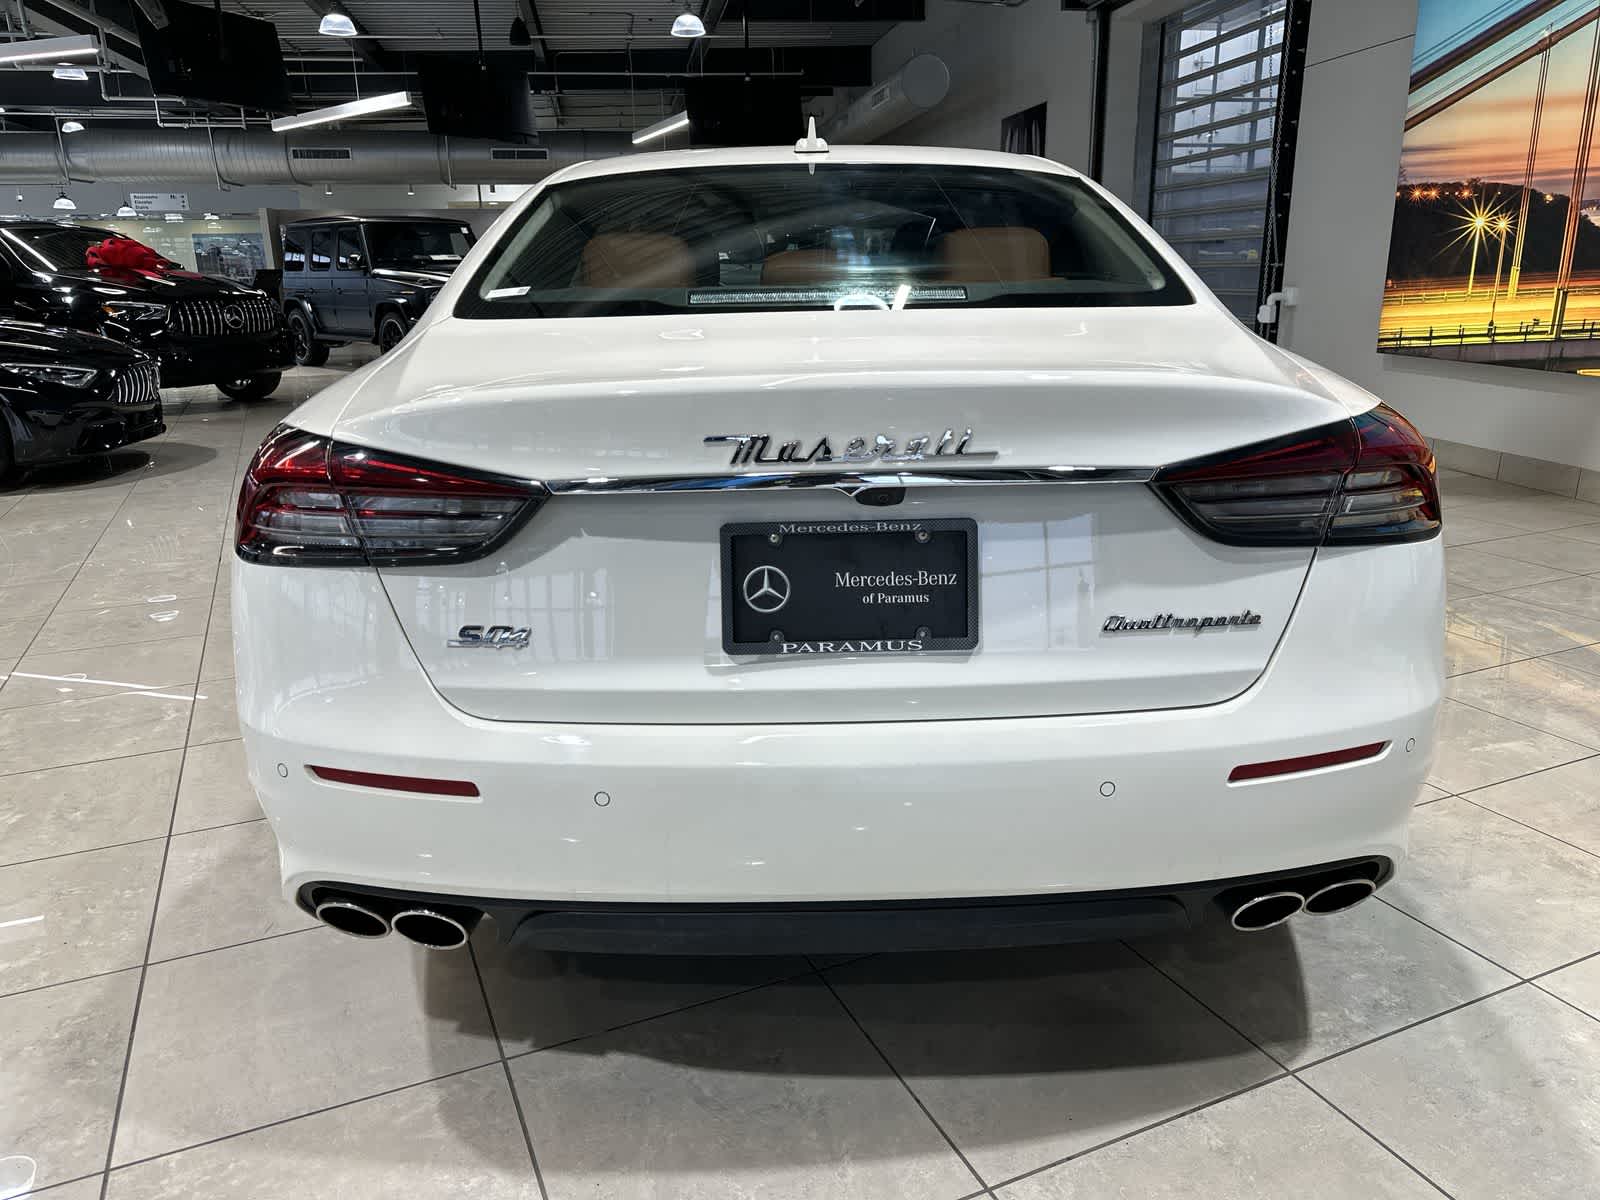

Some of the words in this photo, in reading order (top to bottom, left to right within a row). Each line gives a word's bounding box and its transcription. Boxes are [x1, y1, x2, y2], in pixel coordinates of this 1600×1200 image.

[703, 428, 998, 465] Maserati
[778, 521, 923, 534] Mercedes-Benz
[834, 570, 958, 588] Mercedes-Benz
[862, 592, 875, 604] of
[877, 592, 930, 604] Paramus
[782, 638, 924, 654] PARAMUS
